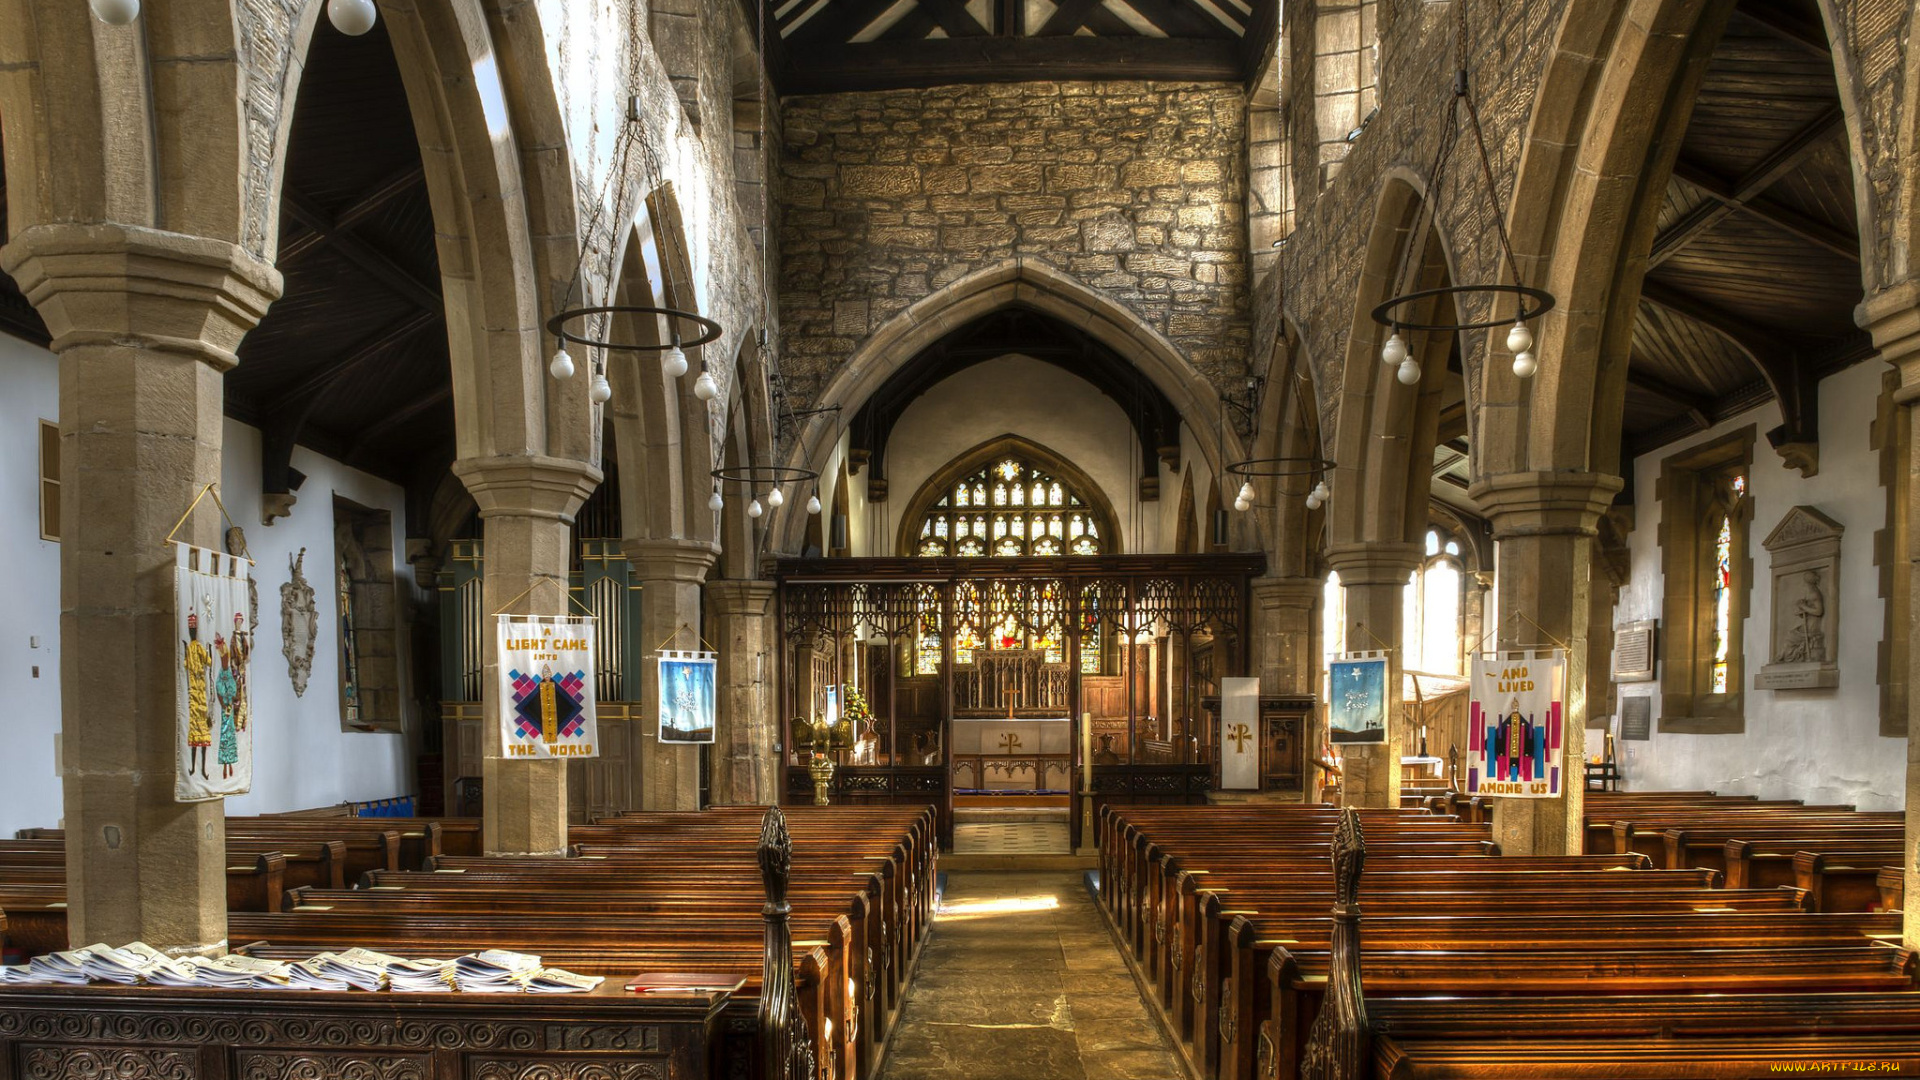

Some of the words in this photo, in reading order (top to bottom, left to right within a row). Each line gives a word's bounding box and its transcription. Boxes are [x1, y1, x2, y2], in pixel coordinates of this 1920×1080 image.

[544, 628, 551, 636] A
[506, 639, 547, 651] LIGHT
[553, 639, 588, 651] CAME
[1502, 667, 1528, 679] AND
[1498, 680, 1534, 693] LIVED
[508, 744, 536, 756] THE
[549, 744, 593, 756] WORLD
[1479, 782, 1523, 794] AMONG
[1530, 783, 1548, 794] US
